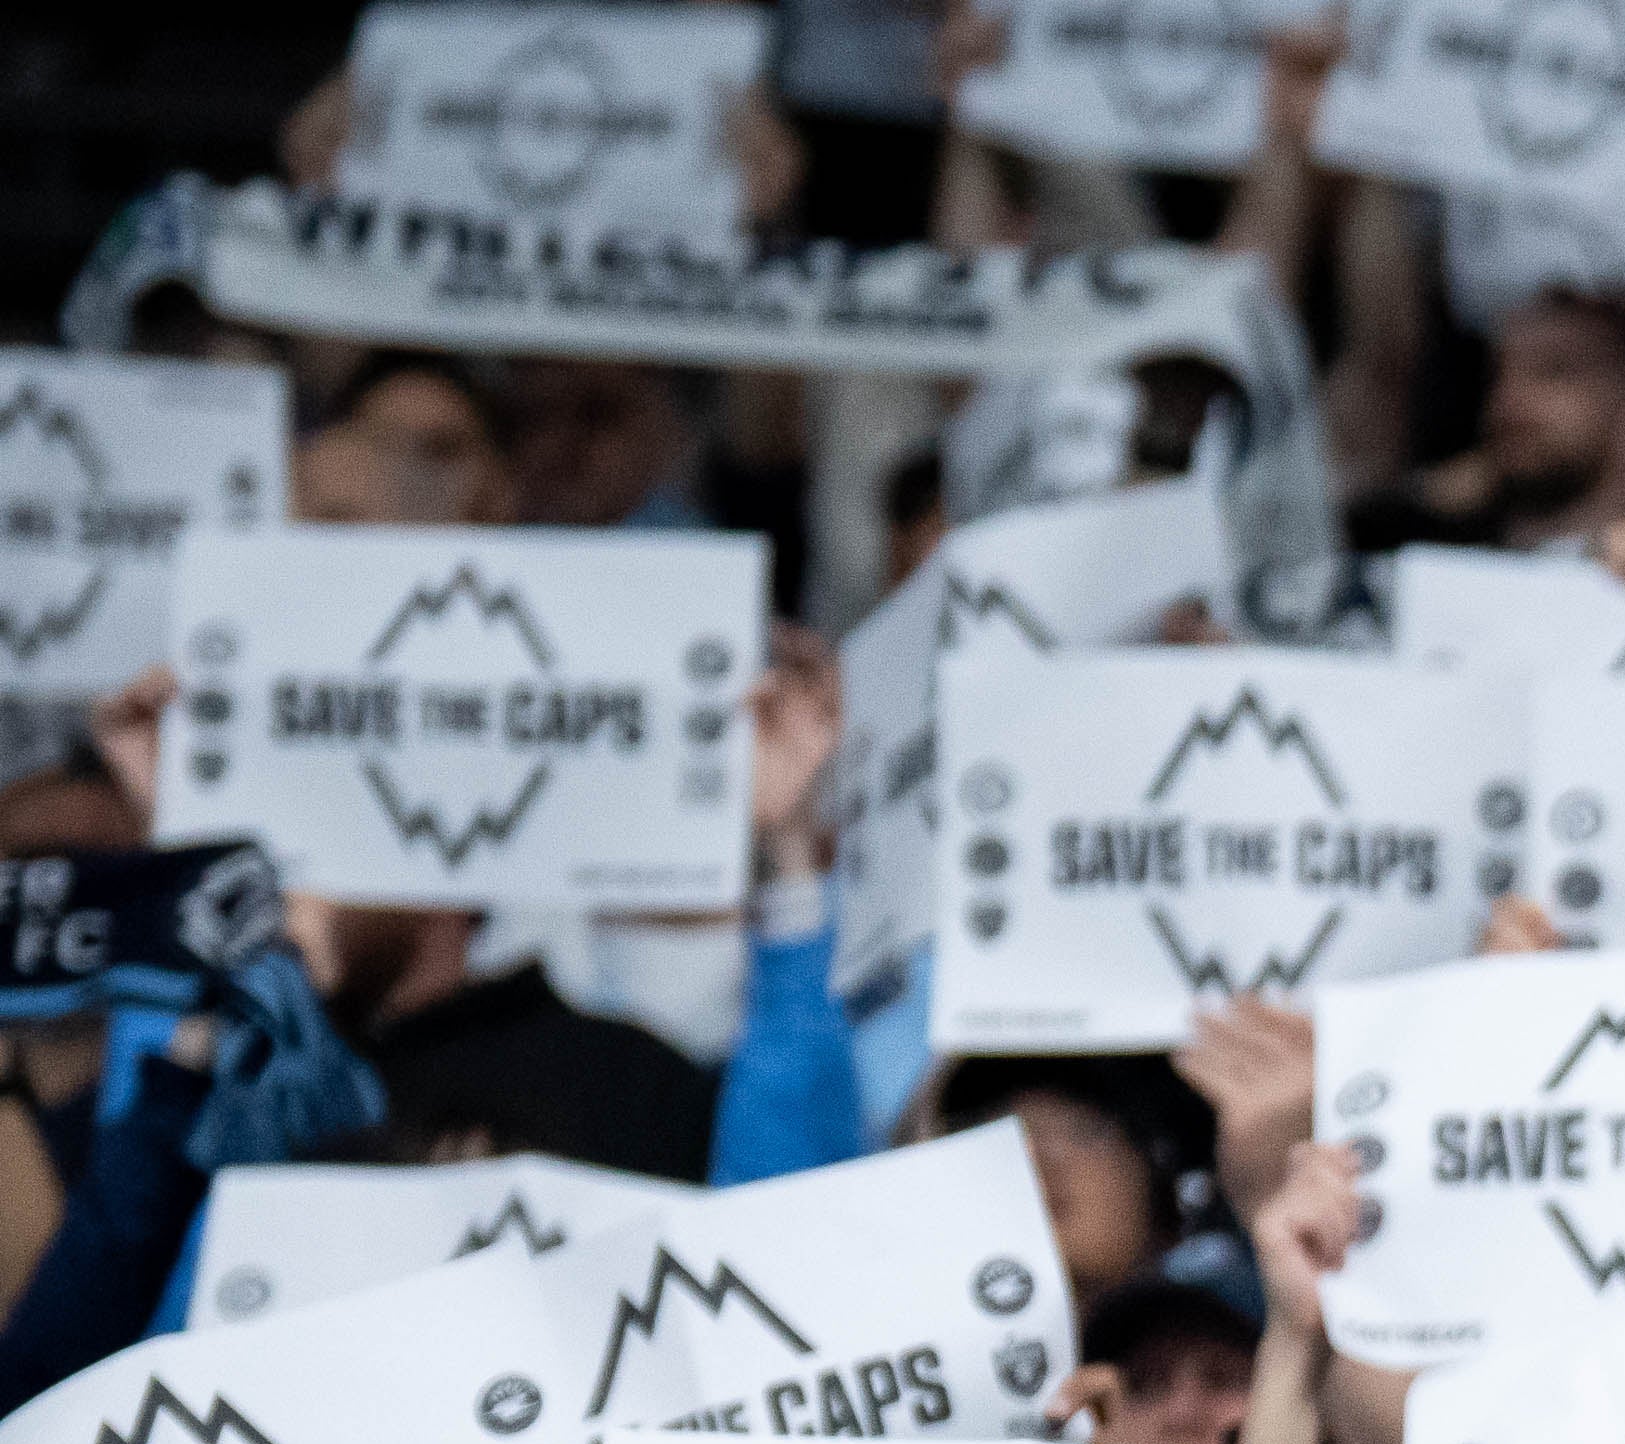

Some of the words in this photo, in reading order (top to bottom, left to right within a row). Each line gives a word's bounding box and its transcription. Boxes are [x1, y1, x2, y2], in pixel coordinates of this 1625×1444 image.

[268, 678, 398, 746] SAVE
[420, 684, 489, 735] THE
[503, 676, 648, 748] CAPS
[1051, 818, 1184, 890] SAVE
[1205, 823, 1280, 878] THE
[1294, 822, 1440, 897] CAPS
[1434, 1108, 1587, 1185] SAVE
[765, 1344, 953, 1438] CAPS
